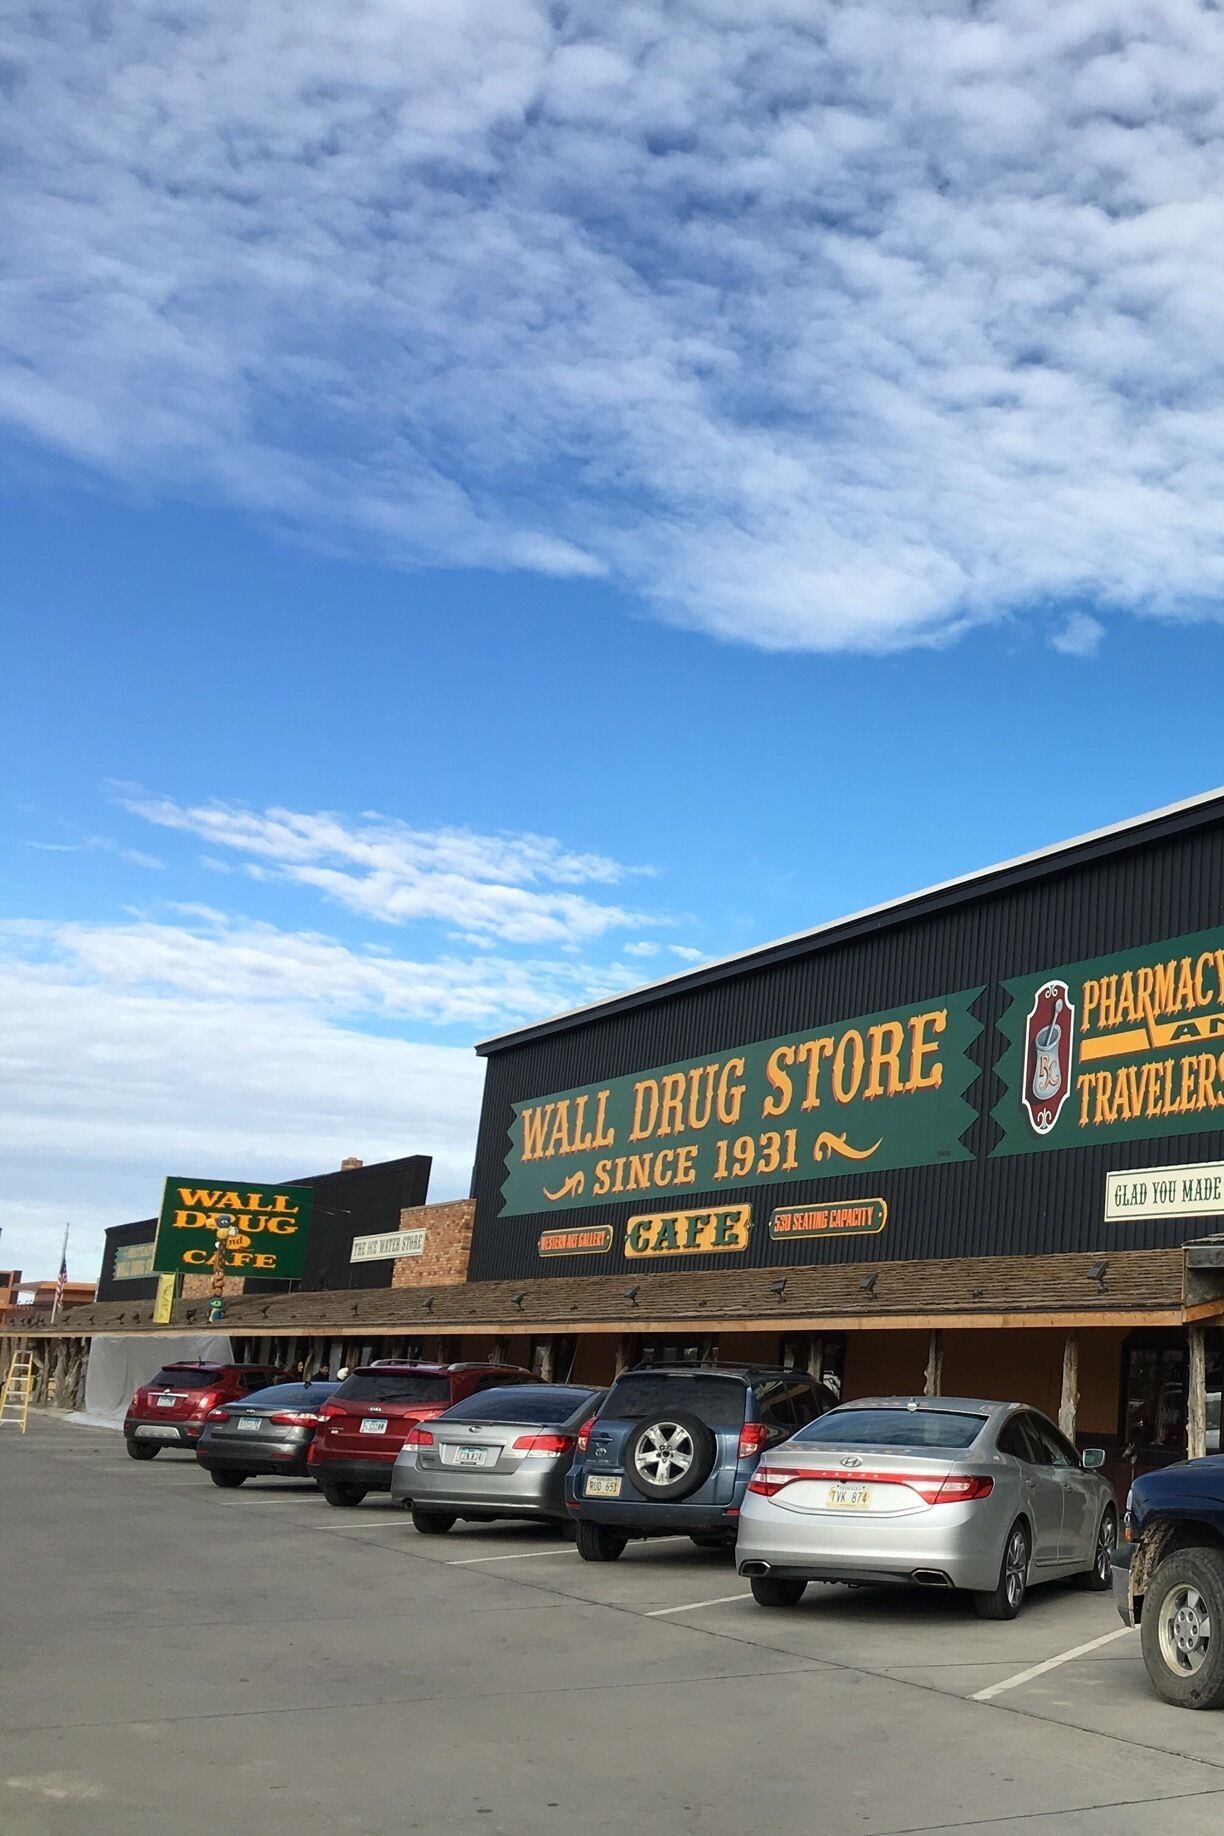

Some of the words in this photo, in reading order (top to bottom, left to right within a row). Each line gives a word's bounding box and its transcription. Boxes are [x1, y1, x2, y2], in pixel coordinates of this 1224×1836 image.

[521, 1088, 617, 1162] WALL
[627, 1056, 746, 1143] DRUG
[761, 1007, 949, 1118] STORE
[592, 1144, 698, 1197] SINCE
[713, 1127, 799, 1181] 1931
[177, 1187, 299, 1214] WALL
[1114, 1182, 1148, 1207] GLAD
[1151, 1180, 1177, 1204] YOU
[1181, 1176, 1222, 1203] MADE
[629, 1210, 742, 1253] CAFE
[774, 1214, 791, 1232] 530
[792, 1210, 828, 1230] SEATING
[829, 1206, 874, 1228] CAPACITY
[353, 1241, 367, 1257] THE
[379, 1237, 400, 1254] WATER
[401, 1234, 423, 1251] STORE
